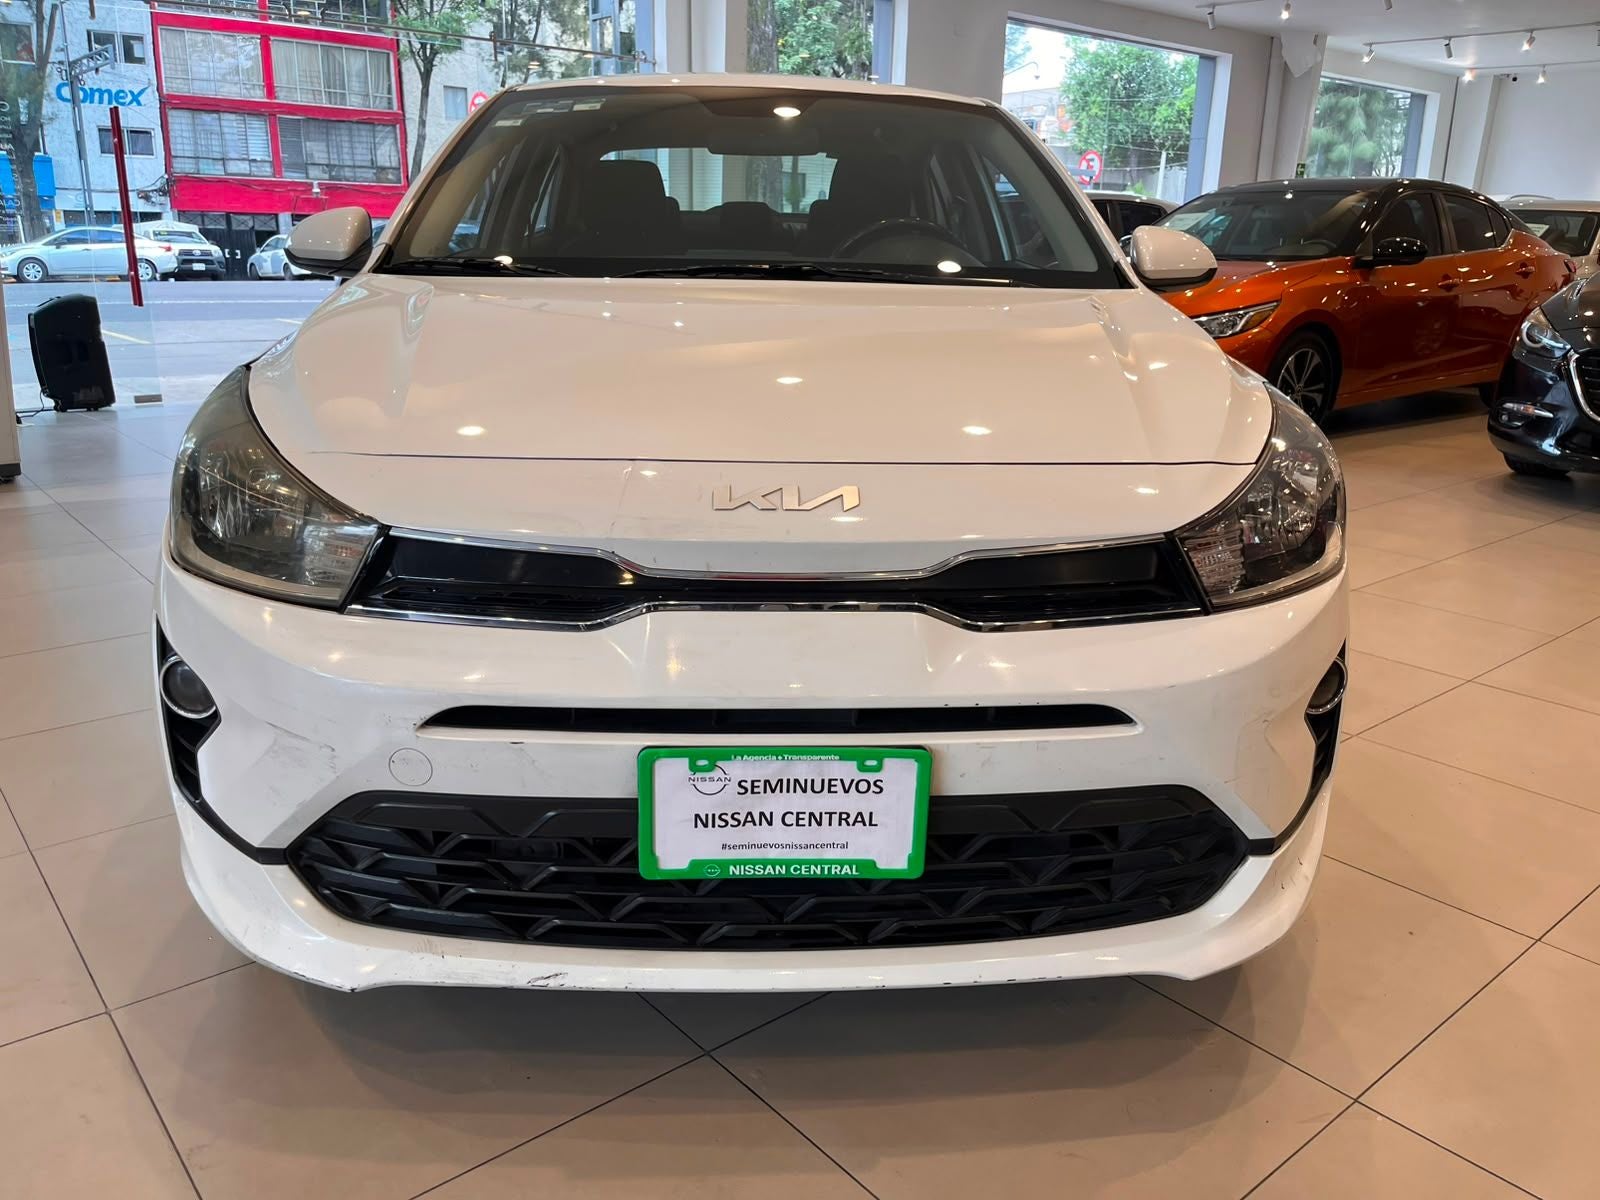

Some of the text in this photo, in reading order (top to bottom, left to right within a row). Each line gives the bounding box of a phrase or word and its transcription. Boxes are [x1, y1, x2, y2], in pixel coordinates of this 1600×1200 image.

[56, 82, 150, 107] Comex
[713, 484, 860, 512] KIA
[742, 754, 777, 762] Agencia
[737, 778, 884, 795] SEMINUEVOS
[694, 811, 878, 829] NISSAN CENTRAL
[721, 841, 849, 851] #seminuevosnissancentral
[729, 864, 860, 875] NISSAN CENTRAL
